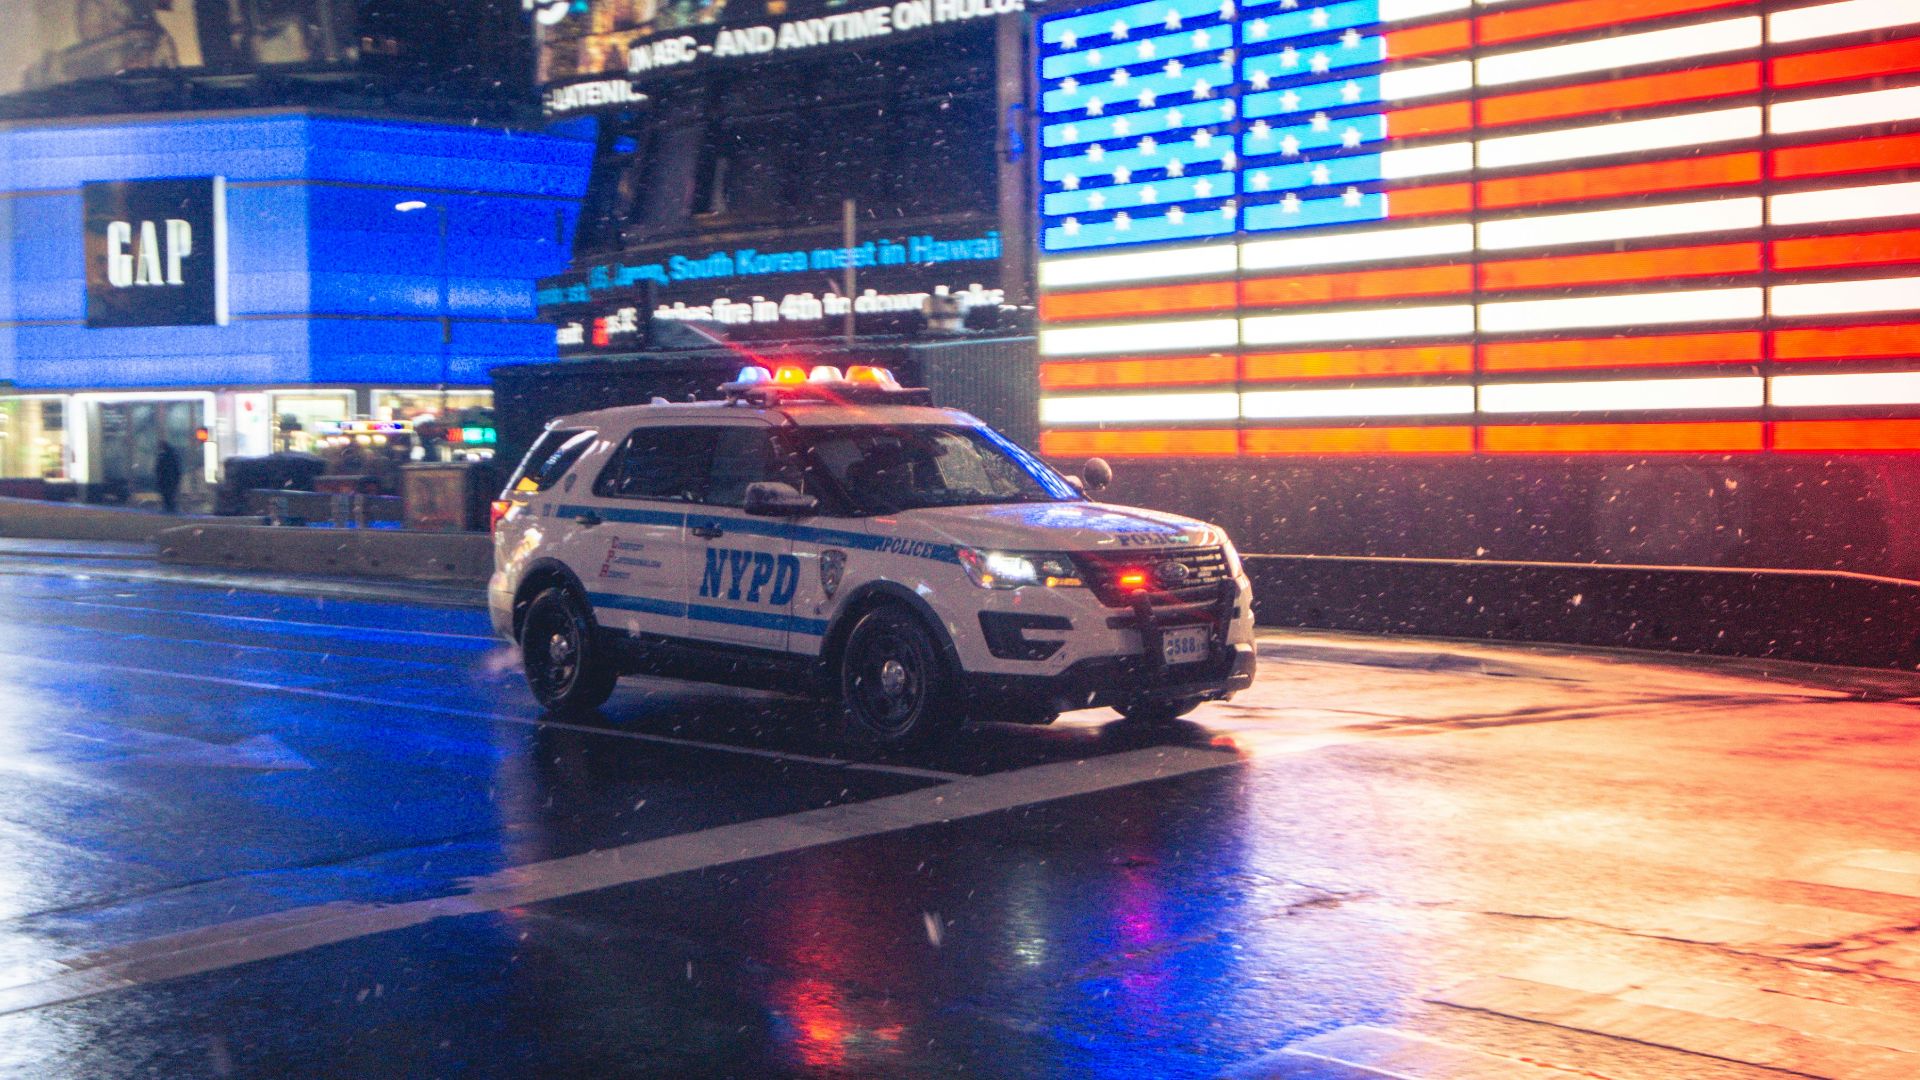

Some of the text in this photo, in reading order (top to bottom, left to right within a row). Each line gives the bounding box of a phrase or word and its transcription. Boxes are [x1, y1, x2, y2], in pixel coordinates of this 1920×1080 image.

[653, 35, 697, 68] ABC
[713, 26, 776, 57] AND
[777, 6, 892, 49] ANYTIME
[892, 1, 932, 31] ON
[107, 219, 192, 287] GAP
[669, 255, 734, 281] South
[734, 249, 808, 276] Korea
[810, 241, 876, 270] meet
[877, 238, 907, 265] in
[752, 295, 779, 322] in
[779, 292, 823, 321] 4th
[879, 536, 931, 558] POLICE
[699, 547, 800, 606] NYPD
